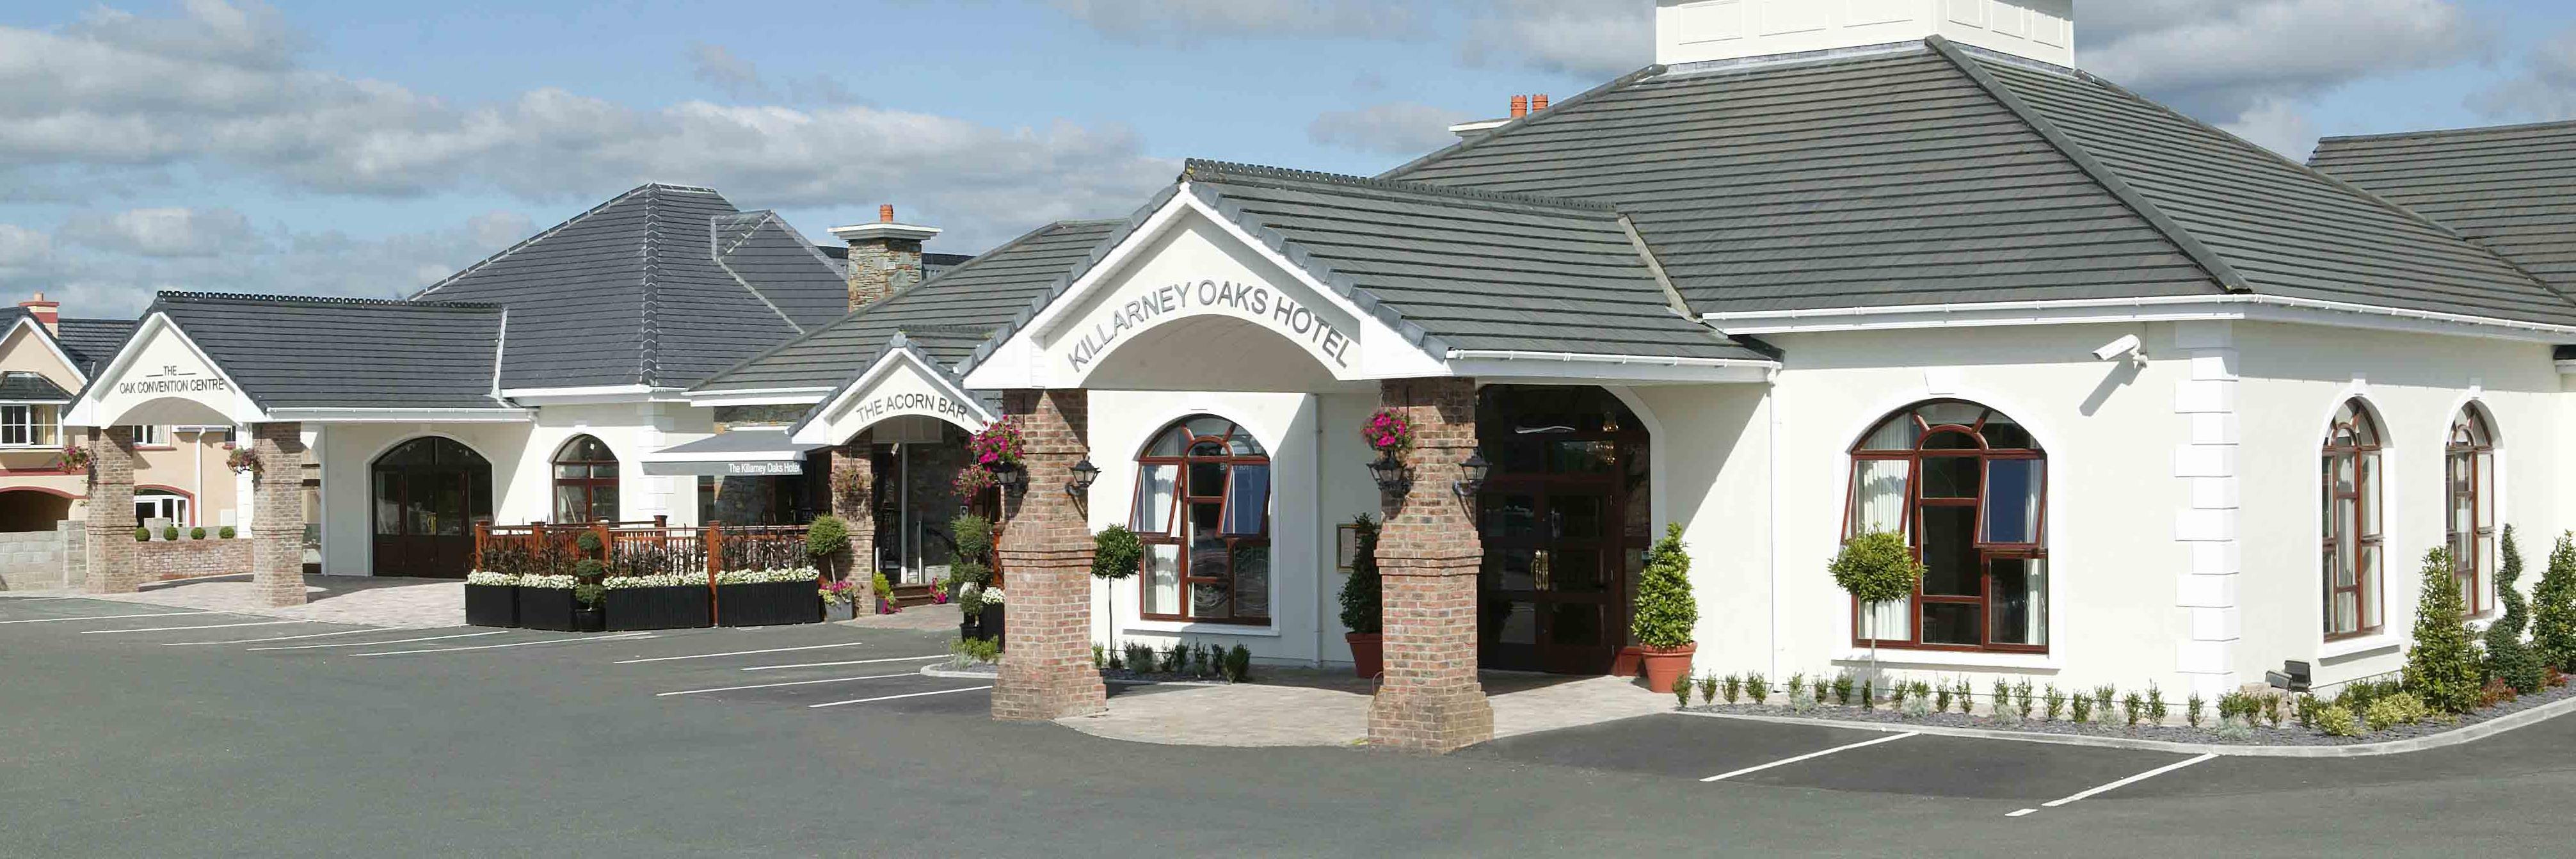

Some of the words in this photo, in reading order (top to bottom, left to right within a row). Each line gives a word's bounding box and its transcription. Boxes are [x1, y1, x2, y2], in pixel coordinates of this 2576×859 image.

[1068, 282, 1191, 373] KILLARNEY
[1198, 280, 1268, 315] OAKS
[1274, 296, 1350, 369] HOTEL
[163, 365, 177, 376] THE
[120, 382, 136, 394] OAK
[137, 380, 188, 394] CONVENTION
[190, 378, 224, 391] CENTRE
[856, 399, 883, 422] THE
[886, 393, 934, 411] ACORN
[938, 397, 967, 422] BAR
[728, 463, 740, 473] The
[741, 463, 766, 475] Killarney
[767, 463, 783, 472] Oaks
